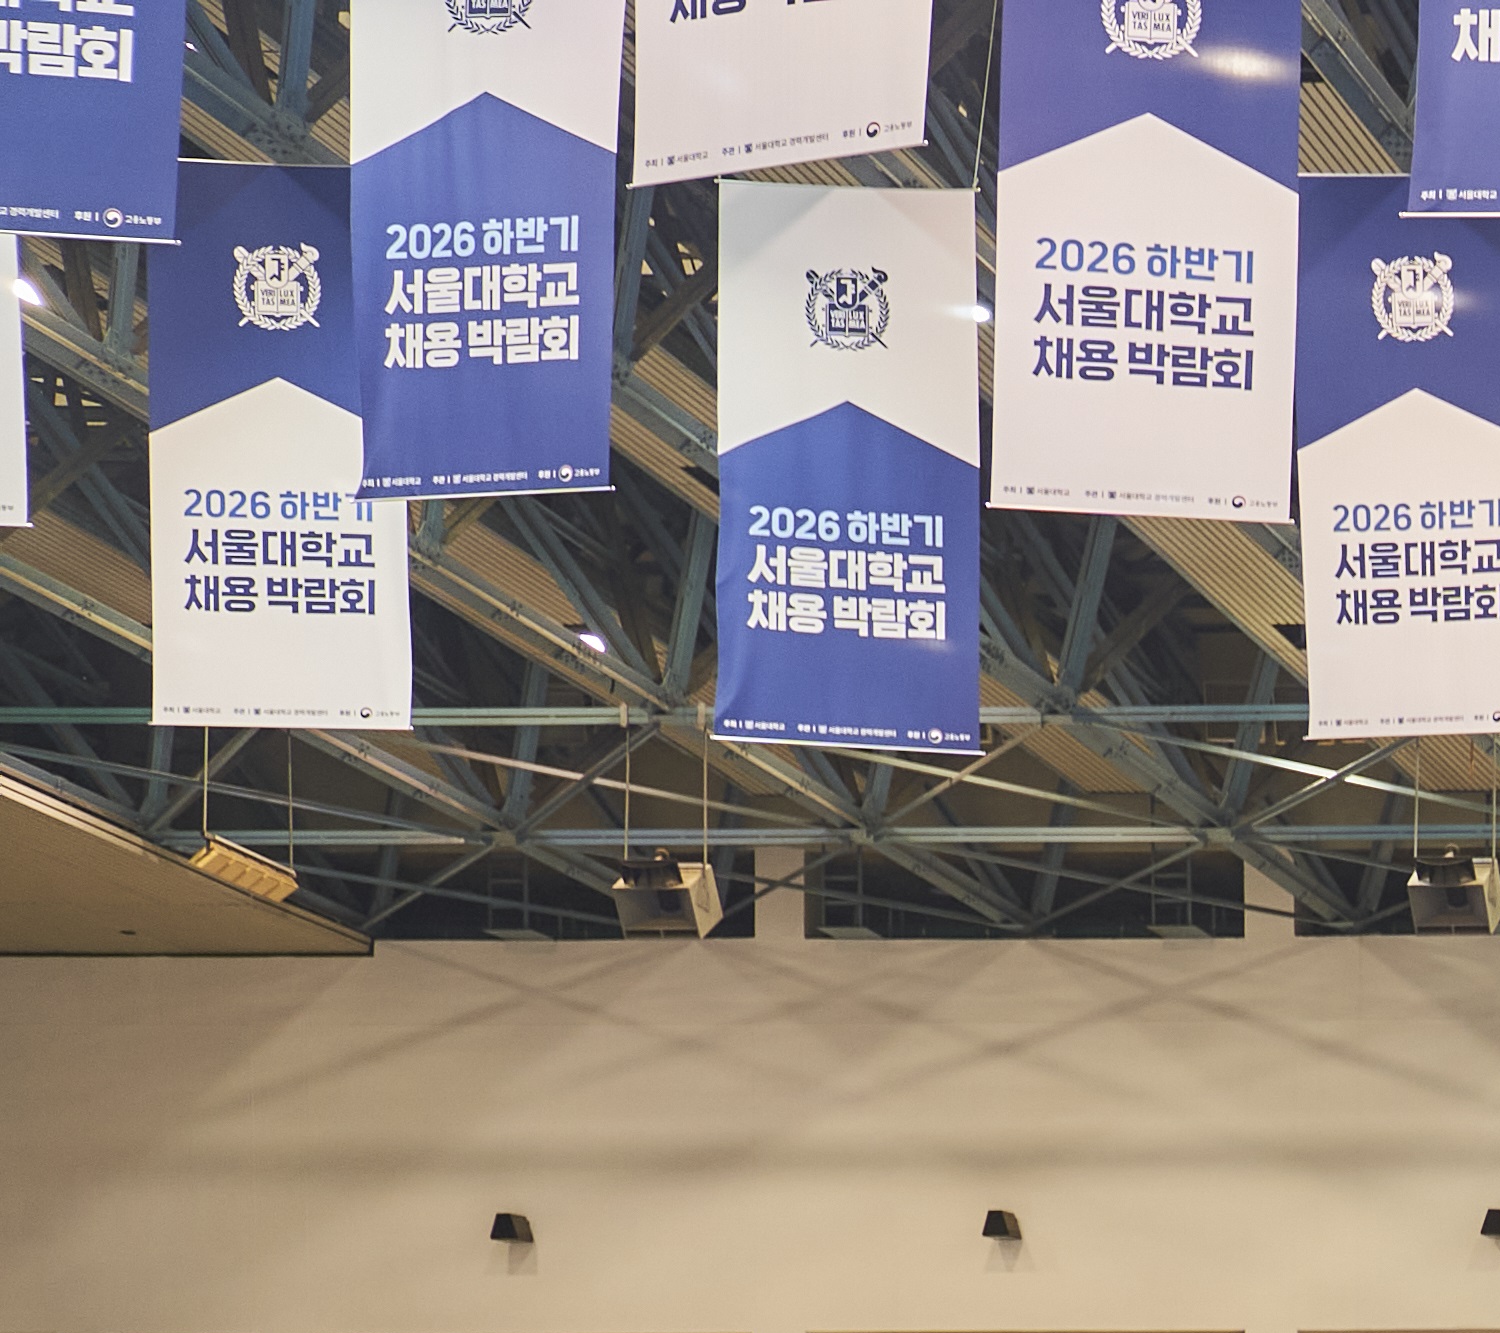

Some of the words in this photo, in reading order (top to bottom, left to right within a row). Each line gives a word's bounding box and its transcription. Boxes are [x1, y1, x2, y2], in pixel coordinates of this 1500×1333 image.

[386, 221, 475, 259] 2026
[482, 215, 578, 254] 하반기
[1036, 238, 1135, 274] 2026
[1146, 244, 1253, 284] 하반기
[385, 262, 579, 314] 서울대학교
[1034, 282, 1254, 337] 서울대학교
[384, 322, 461, 368] 채용
[468, 315, 579, 364] 박람회
[1033, 336, 1118, 381] 채용
[1129, 342, 1253, 390] 박람회
[184, 489, 270, 519] 2026
[749, 506, 840, 541] 2026
[847, 511, 943, 547] 하반기
[1334, 504, 1411, 532] 2026
[185, 529, 375, 567] 서울대학교
[748, 545, 945, 593] 서울대학교
[185, 575, 258, 612] 채용
[267, 578, 375, 615] 박람회
[747, 591, 827, 633] 채용
[834, 596, 945, 640] 박람회
[1336, 589, 1401, 625] 채용
